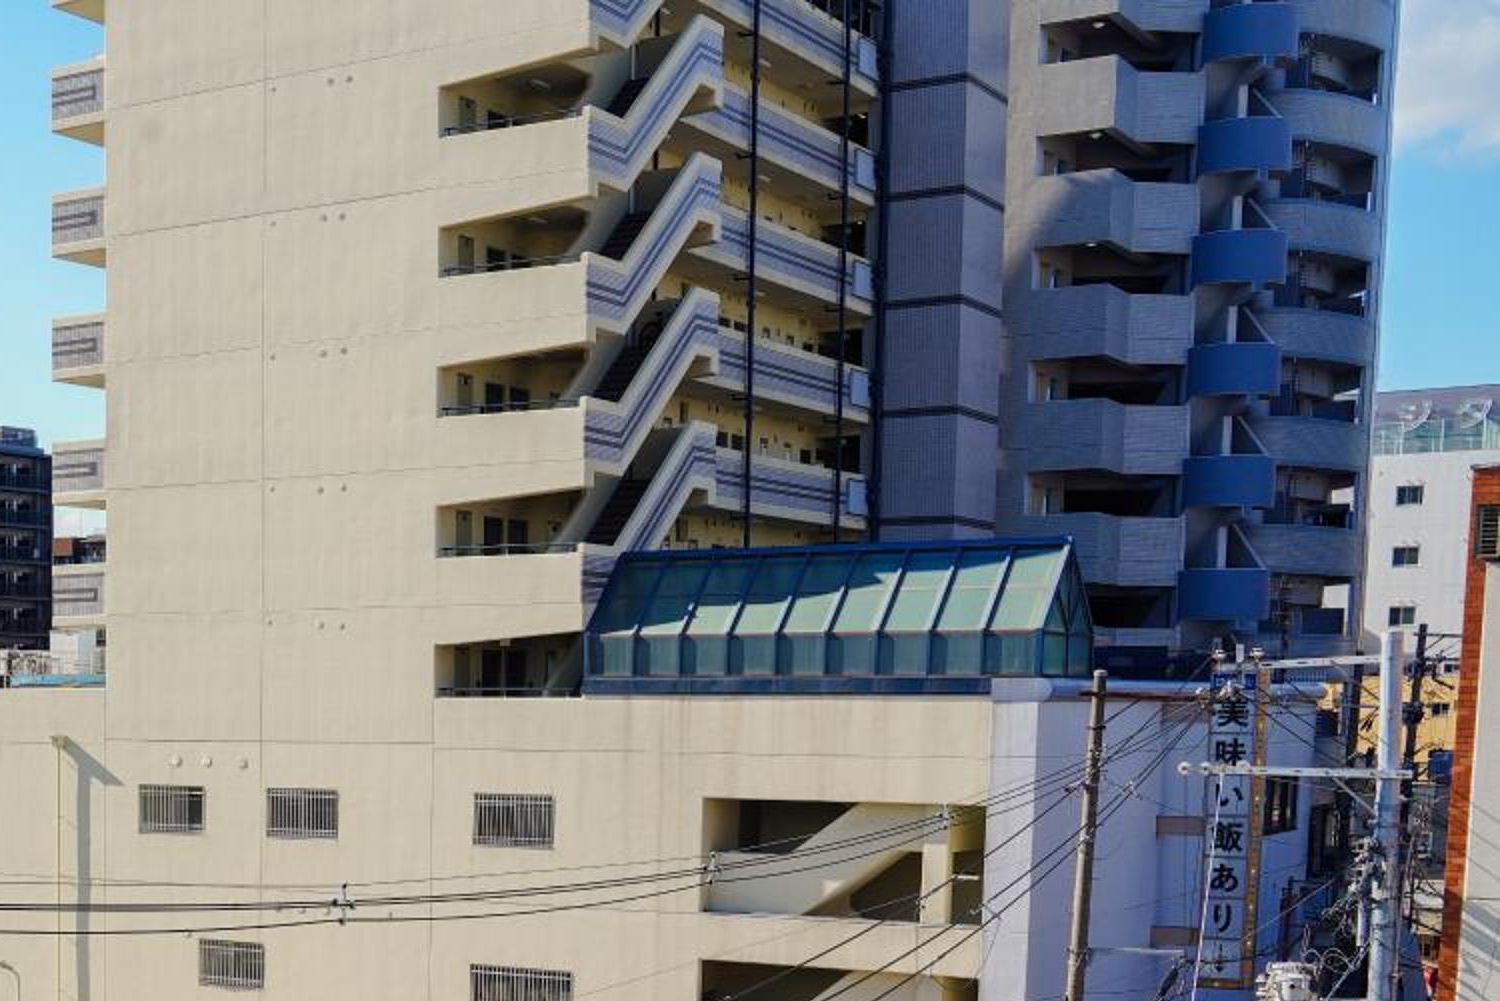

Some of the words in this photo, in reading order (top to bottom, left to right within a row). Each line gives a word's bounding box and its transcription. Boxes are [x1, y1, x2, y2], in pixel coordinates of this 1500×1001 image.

[1208, 696, 1249, 933] 美味い飯あり
